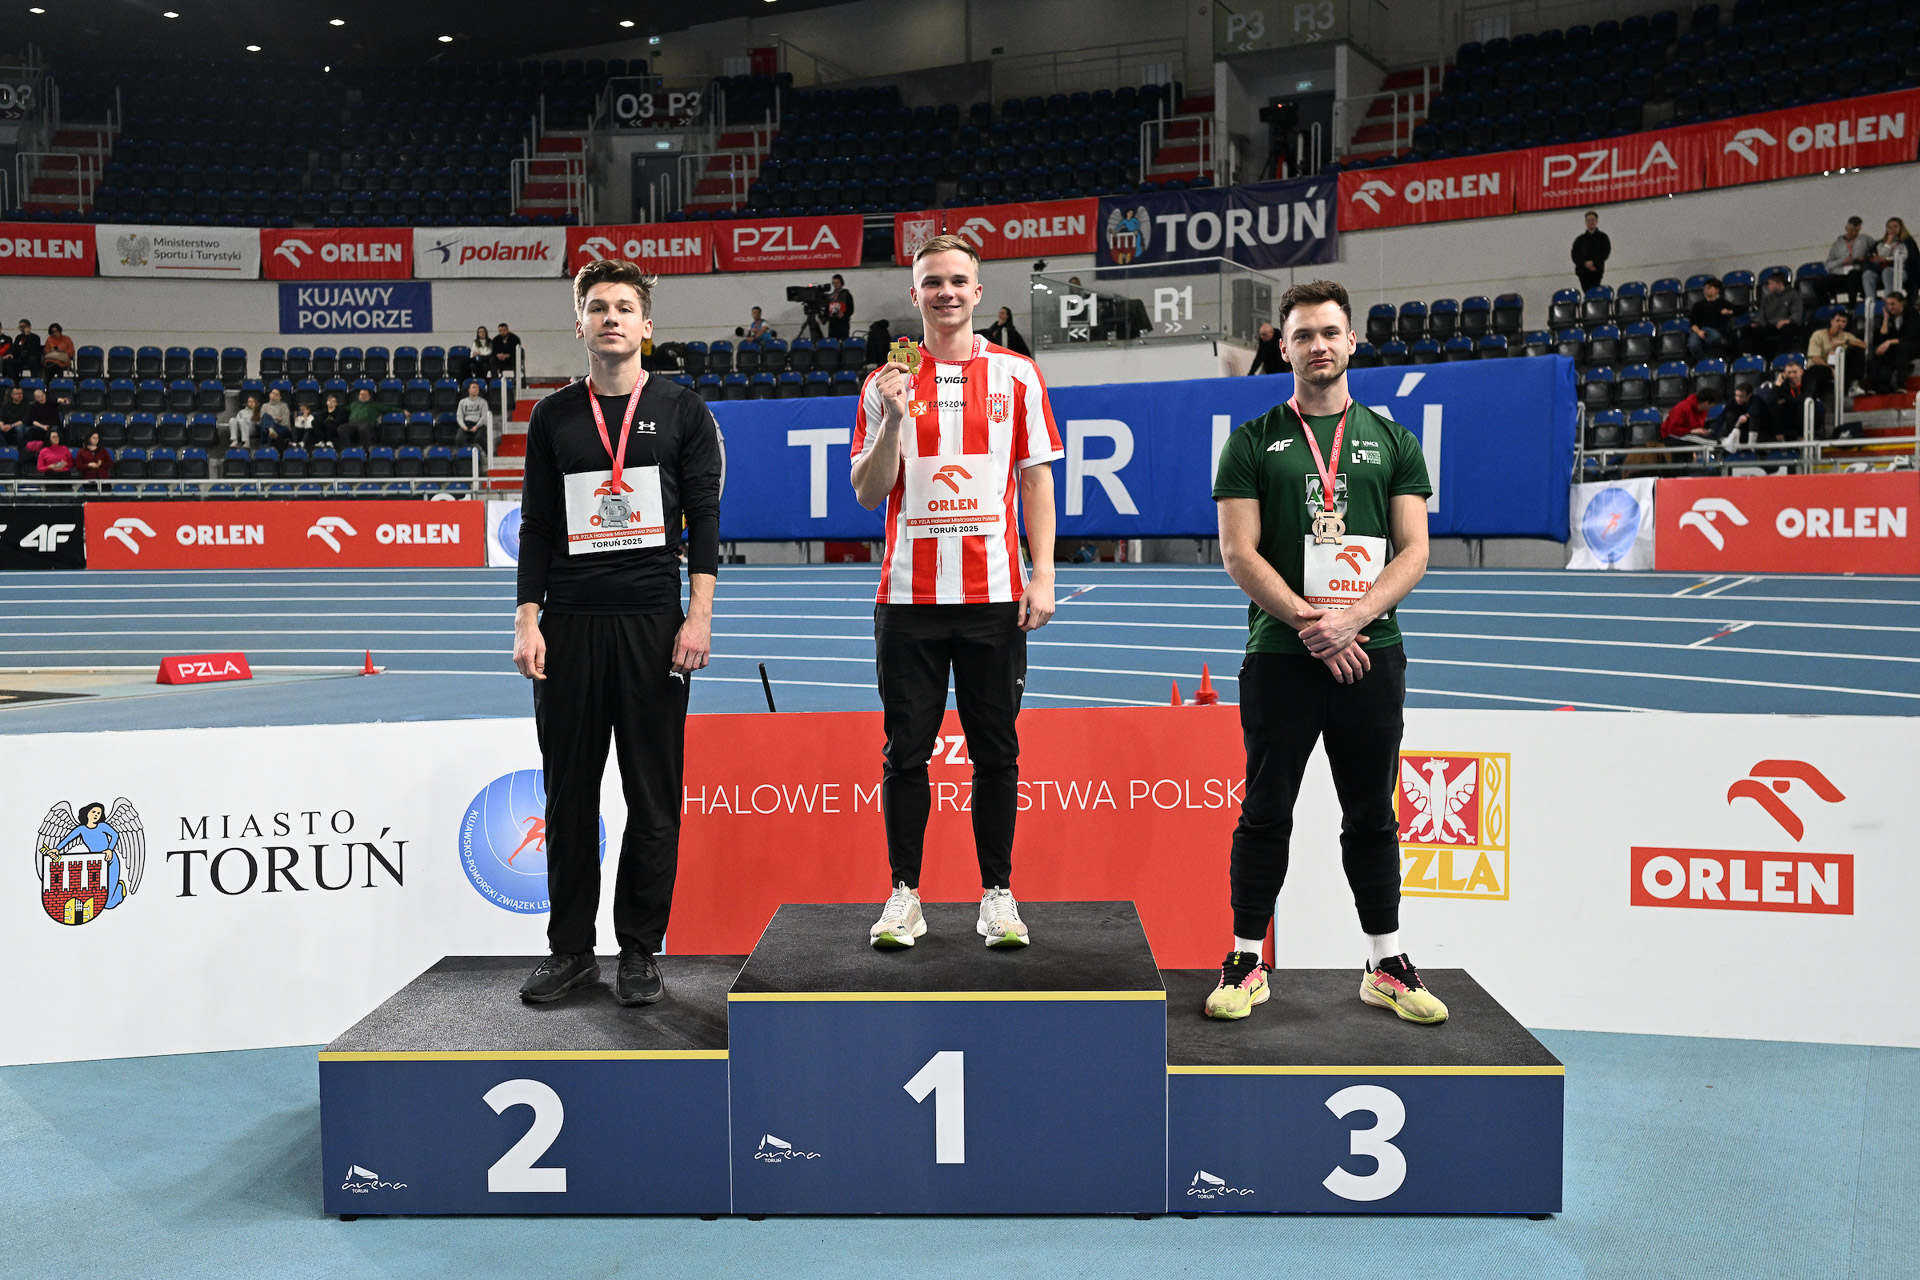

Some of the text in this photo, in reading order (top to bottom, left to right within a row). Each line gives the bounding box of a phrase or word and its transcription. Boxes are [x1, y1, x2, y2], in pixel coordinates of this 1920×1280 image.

[1227, 10, 1265, 42] P3
[616, 93, 654, 118] O3
[668, 92, 702, 117] P3
[1787, 112, 1905, 153] ORLEN
[1543, 140, 1679, 187] PZLA
[1404, 172, 1500, 204] ORLEN
[1004, 215, 1086, 240] ORLEN
[1156, 186, 1326, 252] TORUŃ
[0, 238, 83, 259] ORLEN
[154, 238, 220, 248] Ministerstwo
[623, 237, 702, 258] ORLEN
[733, 224, 841, 253] PZLA
[154, 249, 242, 262] Sportu i Turystyki
[320, 243, 402, 262] ORLEN
[459, 240, 550, 265] polanik
[298, 287, 394, 306] KUJAWY
[1154, 285, 1193, 322] R1
[298, 309, 413, 329] POMORZE
[1059, 292, 1098, 328] P1
[929, 400, 968, 408] rzeszów
[1266, 438, 1293, 452] 4F
[928, 498, 978, 512] ORLEN
[176, 524, 265, 546] ORLEN
[375, 523, 460, 544] ORLEN
[929, 525, 957, 534] TORUŃ
[1776, 507, 1907, 538] ORLEN
[20, 524, 76, 552] 4F
[592, 538, 643, 549] TORUŃ 2025
[1329, 579, 1372, 593] ORLEN
[178, 660, 240, 678] PZLA
[683, 783, 840, 814] HALOWE
[1130, 779, 1246, 809] POLSK
[179, 810, 355, 841] MIASTO
[166, 827, 409, 897] TORUŃ
[463, 809, 536, 911] KUJAWSKO-POMORSKI ZWIĄZEK
[1399, 849, 1501, 892] ZLA
[1641, 855, 1839, 906] ORLEN
[903, 1051, 965, 1163] 1
[482, 1078, 567, 1193] 2
[1322, 1084, 1407, 1201] 3
[754, 1150, 821, 1160] arena
[341, 1180, 408, 1190] arena
[1187, 1185, 1255, 1196] arena
